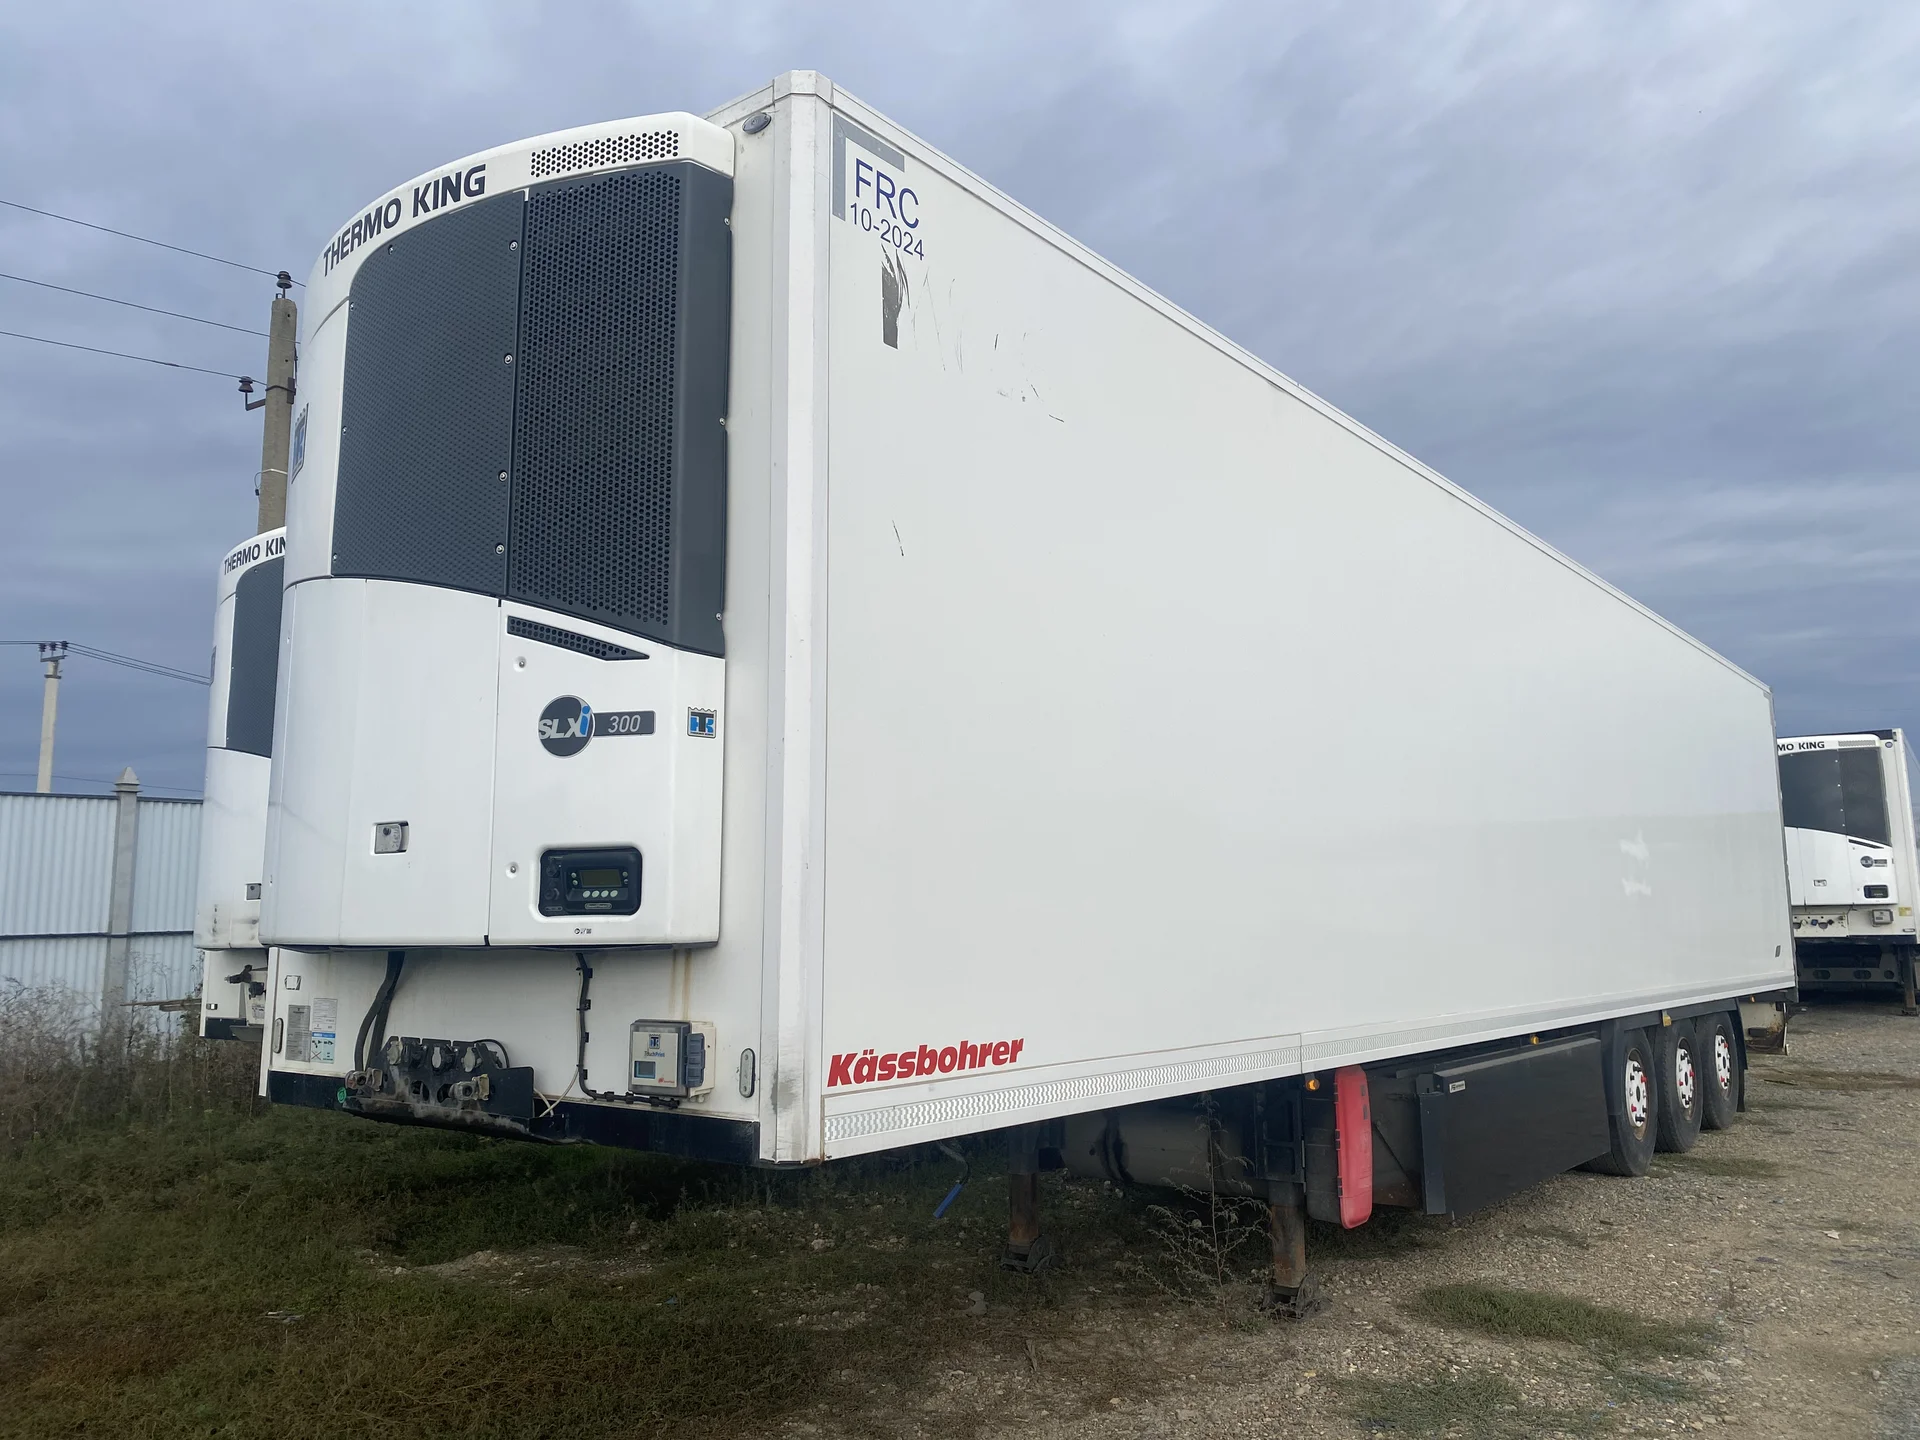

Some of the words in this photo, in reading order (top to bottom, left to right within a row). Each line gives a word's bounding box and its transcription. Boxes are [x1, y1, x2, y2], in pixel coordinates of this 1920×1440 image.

[855, 157, 920, 229] FRC
[322, 197, 402, 277] THERMO
[412, 163, 486, 218] KING
[850, 202, 925, 261] 10-2024
[224, 543, 260, 575] THERMO
[265, 536, 286, 557] KIN
[607, 714, 641, 733] 300
[1798, 741, 1825, 750] KING
[827, 1038, 1024, 1087] Kässbohrer
